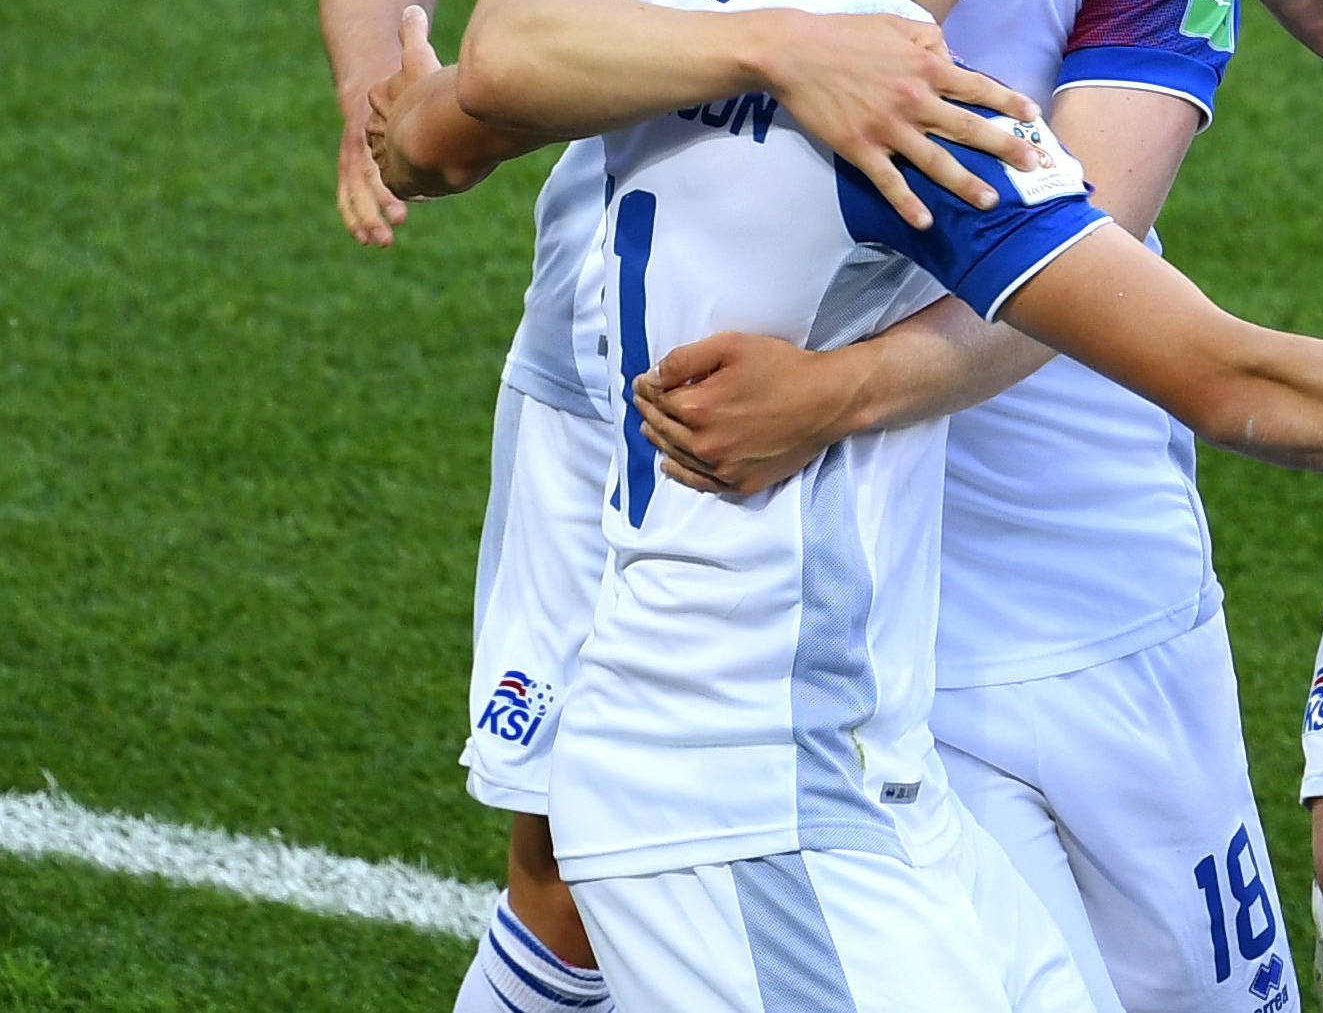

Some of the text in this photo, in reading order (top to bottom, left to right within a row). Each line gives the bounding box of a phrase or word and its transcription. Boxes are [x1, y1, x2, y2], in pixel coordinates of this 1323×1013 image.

[677, 92, 779, 145] ON
[609, 175, 657, 530] 1
[476, 699, 542, 747] KSI
[1193, 821, 1276, 984] 18
